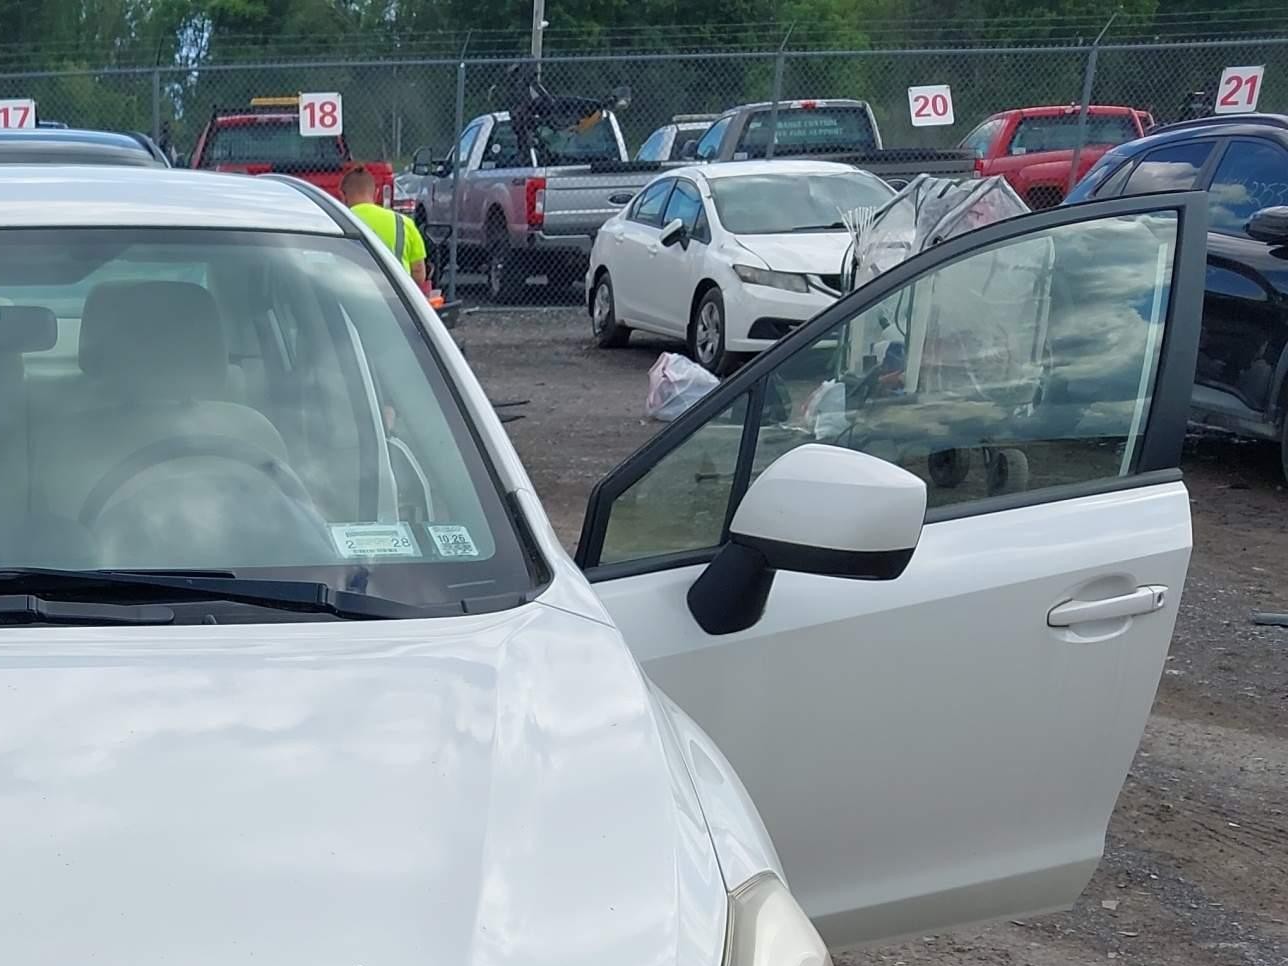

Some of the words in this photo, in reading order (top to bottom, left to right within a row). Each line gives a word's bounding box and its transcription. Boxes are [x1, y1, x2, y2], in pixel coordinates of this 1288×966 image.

[1219, 75, 1258, 106] 21
[303, 102, 337, 128] 18
[913, 94, 948, 117] 20
[346, 540, 355, 549] 2
